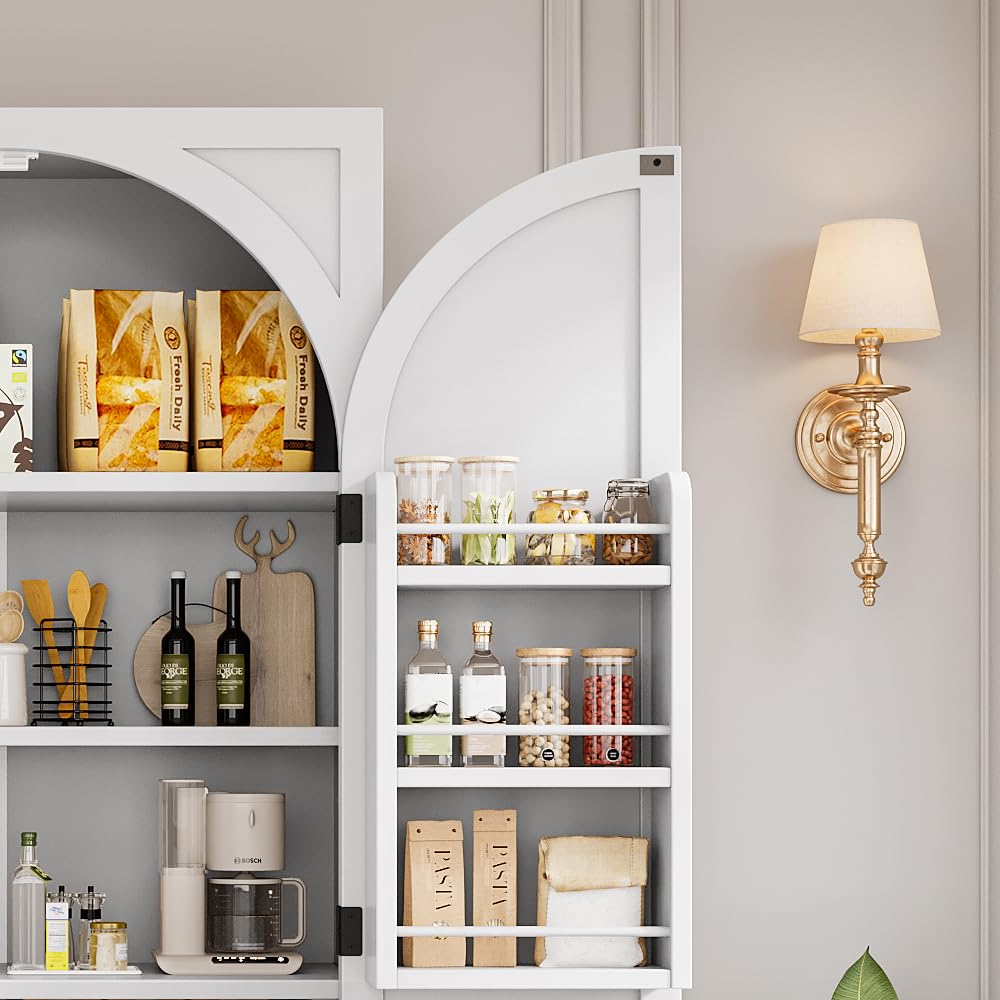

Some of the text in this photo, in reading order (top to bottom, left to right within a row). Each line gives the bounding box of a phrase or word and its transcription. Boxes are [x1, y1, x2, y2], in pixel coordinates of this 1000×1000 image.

[172, 396, 183, 431] Daily
[297, 396, 309, 431] Daily
[434, 850, 453, 910] PASTA
[492, 845, 508, 906] PASTA
